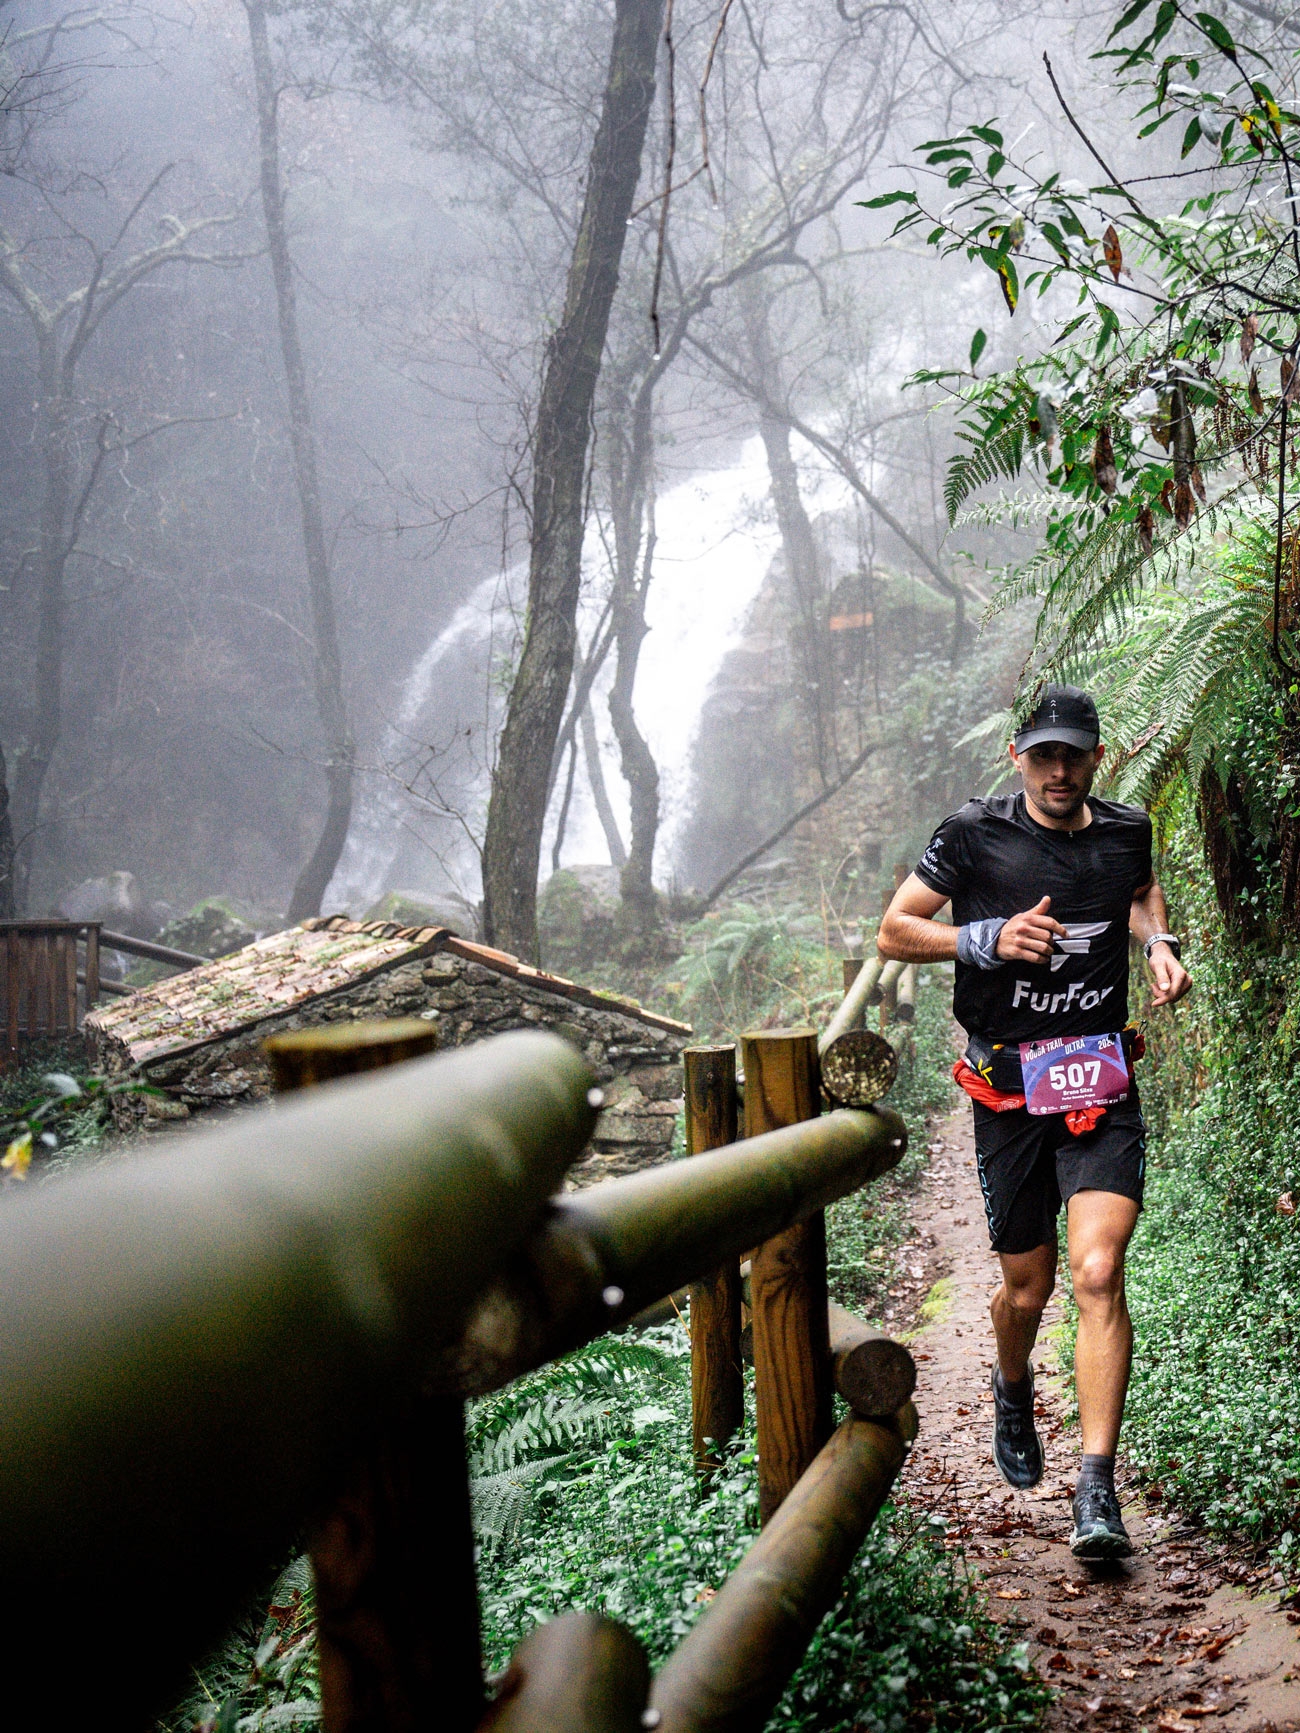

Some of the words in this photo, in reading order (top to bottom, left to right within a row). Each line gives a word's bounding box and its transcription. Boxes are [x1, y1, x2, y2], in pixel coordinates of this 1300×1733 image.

[1012, 980, 1114, 1014] FurFor
[1046, 1037, 1065, 1053] TRAIL
[1064, 1039, 1086, 1055] ULTRA
[1049, 1060, 1101, 1091] 507
